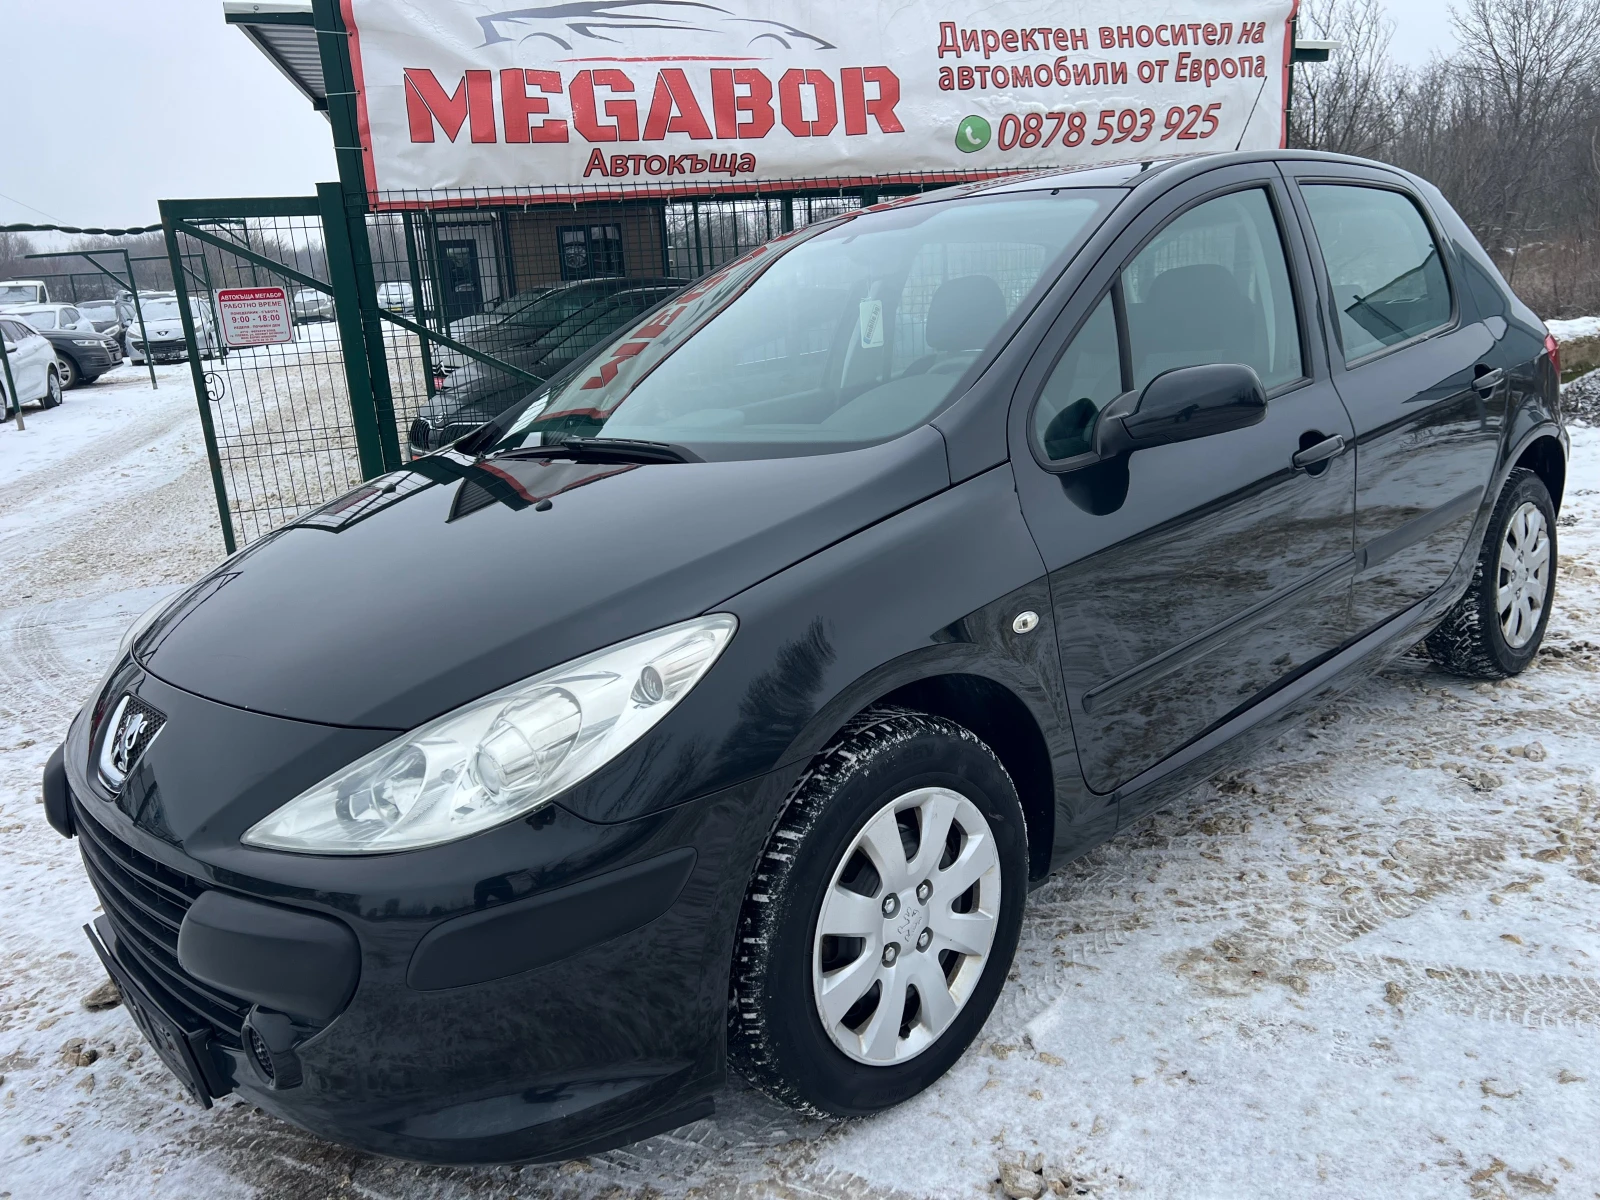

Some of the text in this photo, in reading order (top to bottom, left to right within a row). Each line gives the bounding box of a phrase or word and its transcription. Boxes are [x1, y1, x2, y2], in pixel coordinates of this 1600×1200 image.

[938, 21, 1266, 59] Директен вносител на
[938, 51, 1266, 91] автомобили от Европа
[403, 66, 905, 144] MEGABOR
[998, 103, 1222, 152] 0878 593 925
[583, 148, 757, 178] Автокъща
